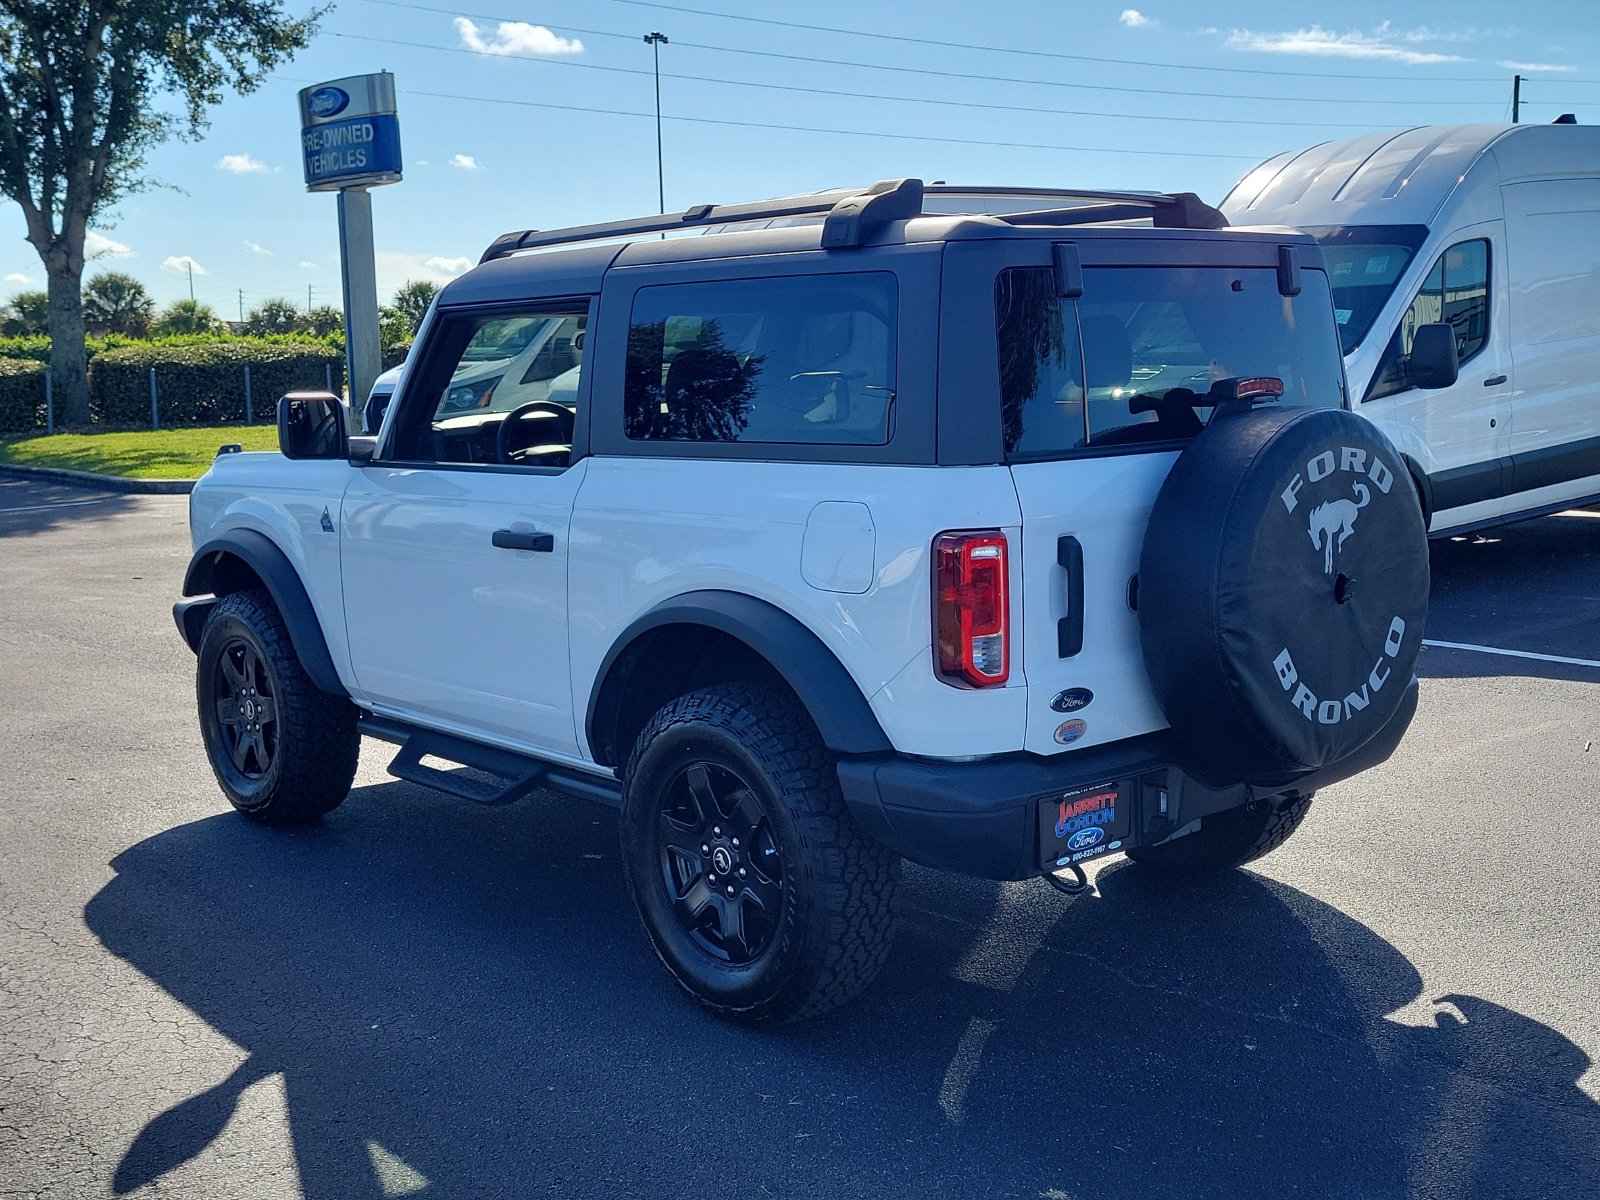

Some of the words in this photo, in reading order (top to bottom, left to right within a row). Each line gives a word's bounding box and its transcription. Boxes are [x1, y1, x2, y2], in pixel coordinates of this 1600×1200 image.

[308, 149, 366, 174] VEHICLES
[1281, 446, 1394, 515] FORD
[1272, 616, 1406, 725] BRONCO
[1062, 695, 1085, 708] Ford
[1055, 808, 1115, 838] GORDON
[1059, 793, 1118, 826] JARRETT
[1074, 831, 1097, 848] Ford
